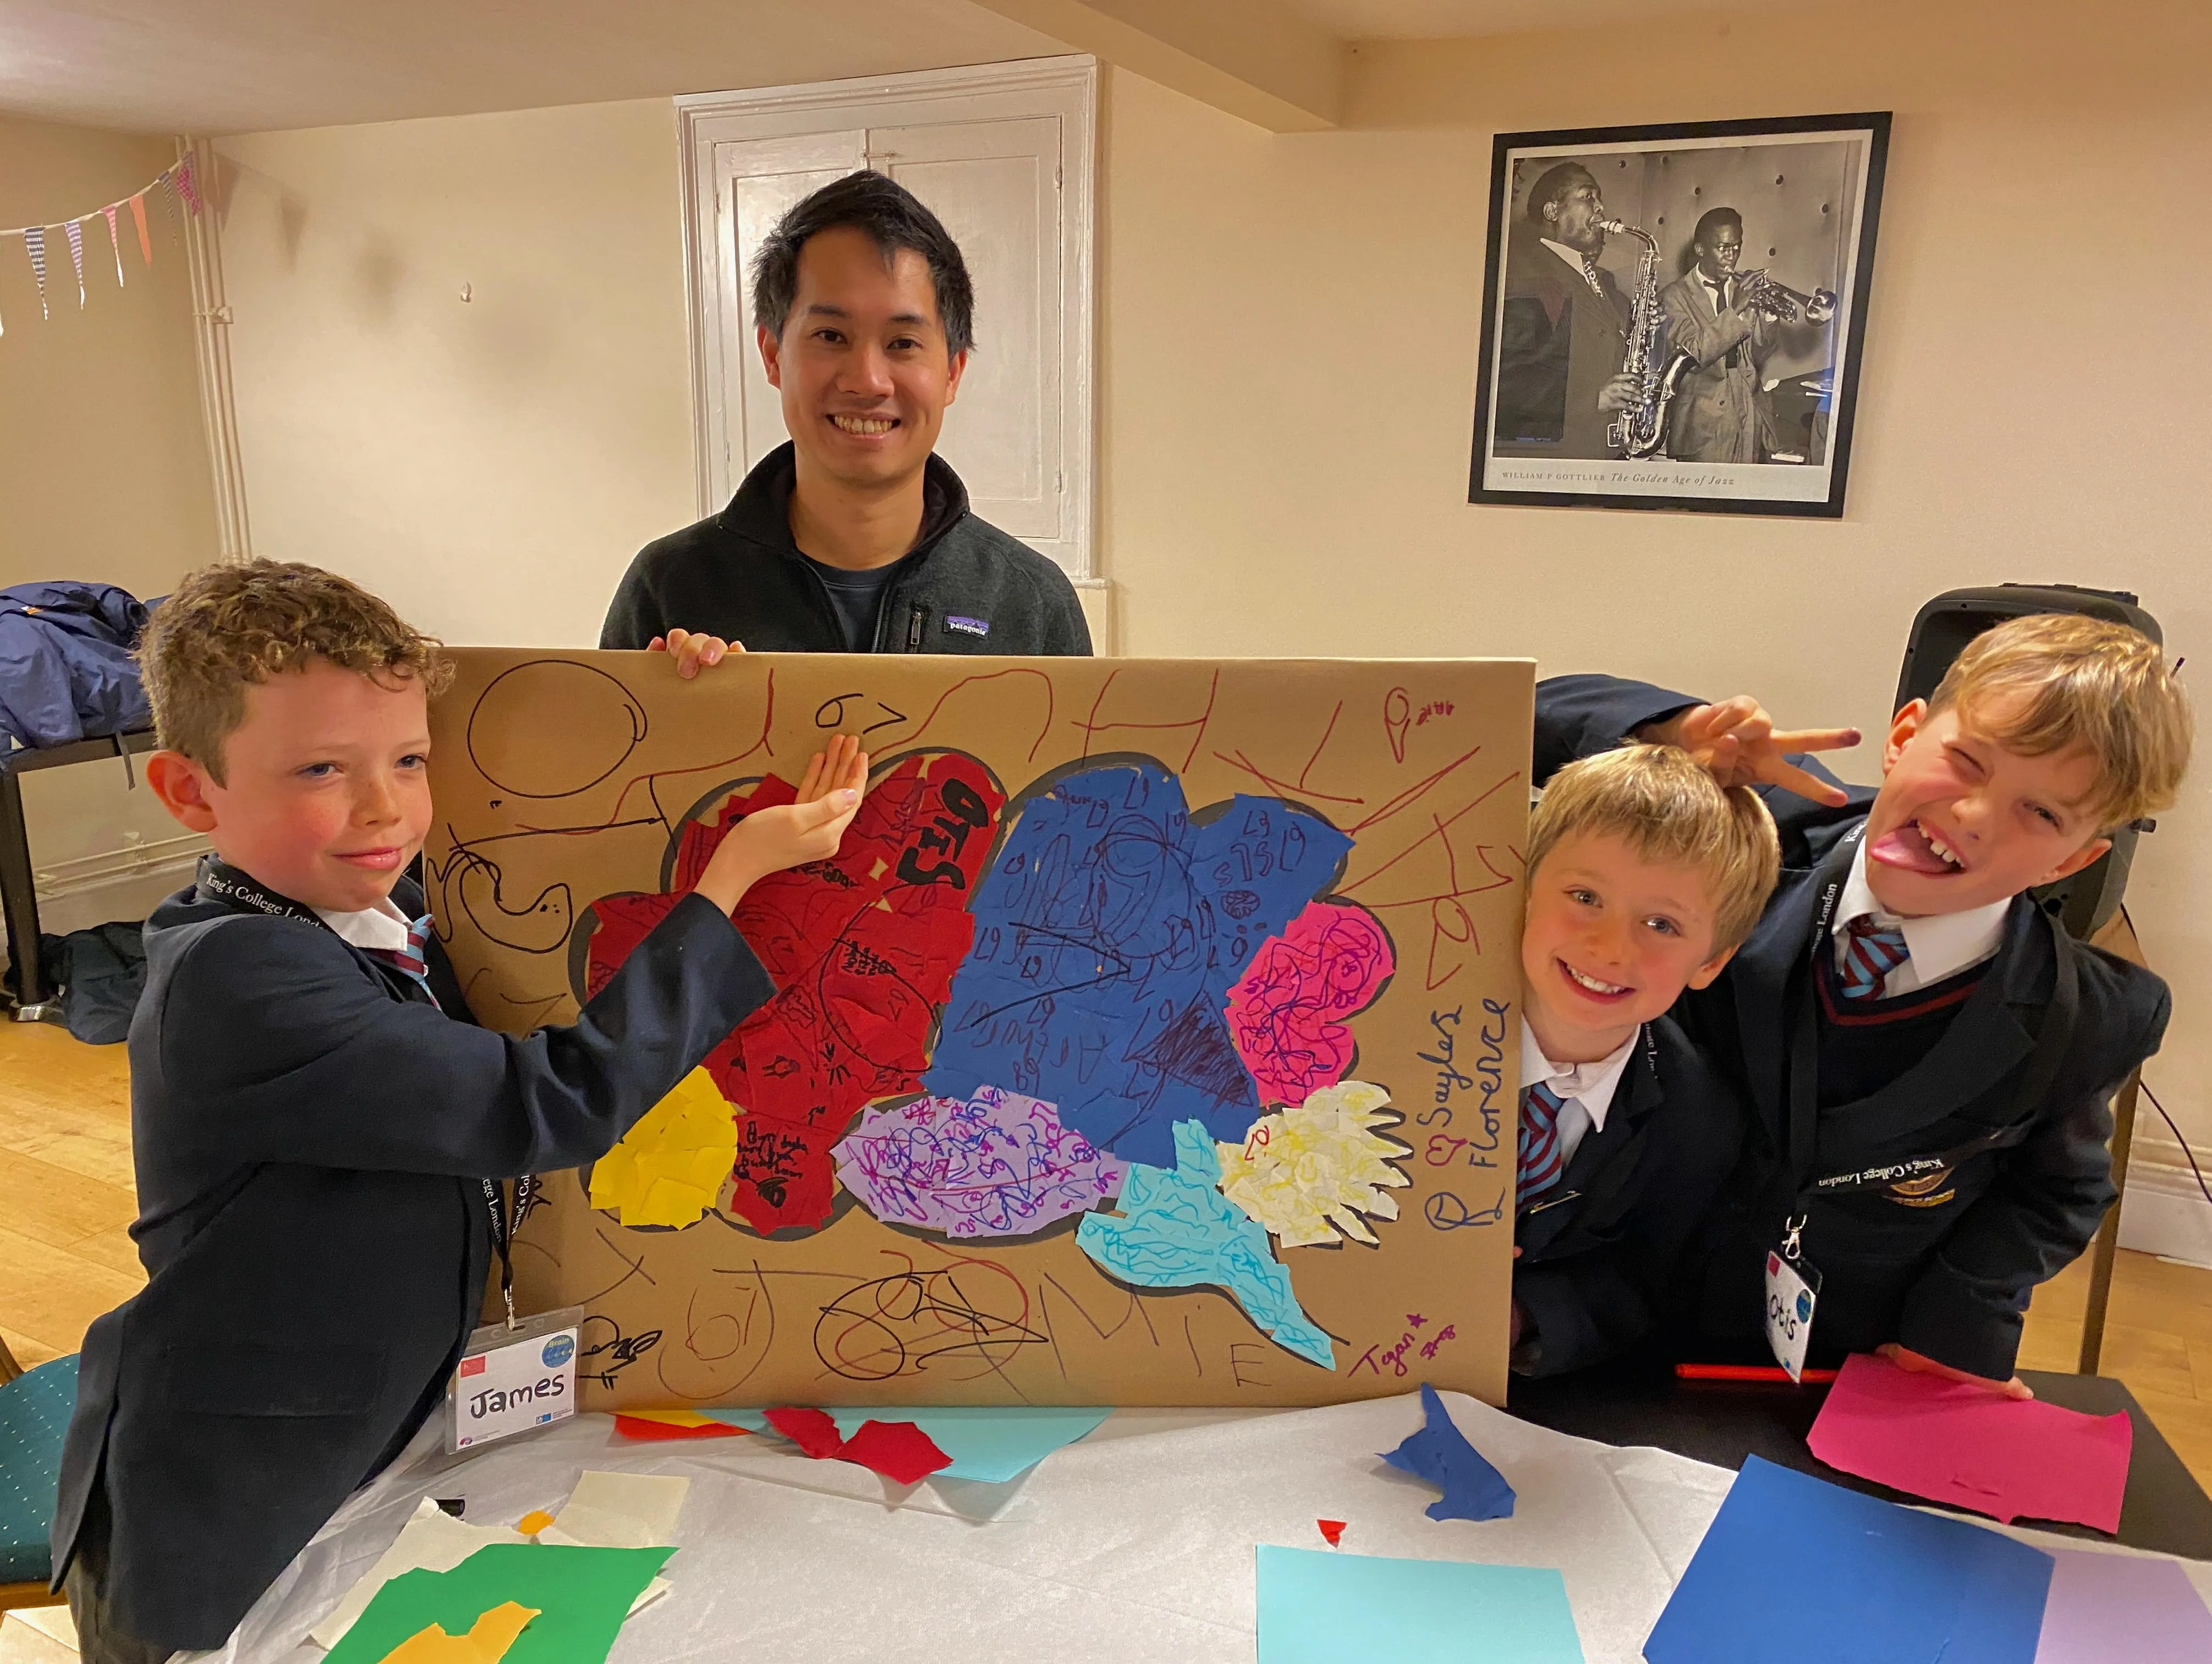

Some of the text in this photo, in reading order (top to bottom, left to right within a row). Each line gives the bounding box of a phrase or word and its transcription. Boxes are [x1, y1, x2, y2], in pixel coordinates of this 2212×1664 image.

[1502, 472, 1543, 480] WILLIAM
[1555, 473, 1605, 481] GOTTLIEB
[1611, 473, 1629, 482] The
[1633, 473, 1668, 483] Golden
[1672, 476, 1691, 485] Age
[1694, 475, 1707, 485] of
[1709, 476, 1735, 486] Jazz
[950, 622, 986, 636] patagonia
[206, 873, 235, 895] King's
[235, 886, 283, 915] College
[1817, 883, 1838, 926] London
[1818, 1158, 1944, 1187] King's College London
[488, 1198, 502, 1244] London
[548, 1337, 570, 1348] Brain
[470, 1374, 564, 1419] James
